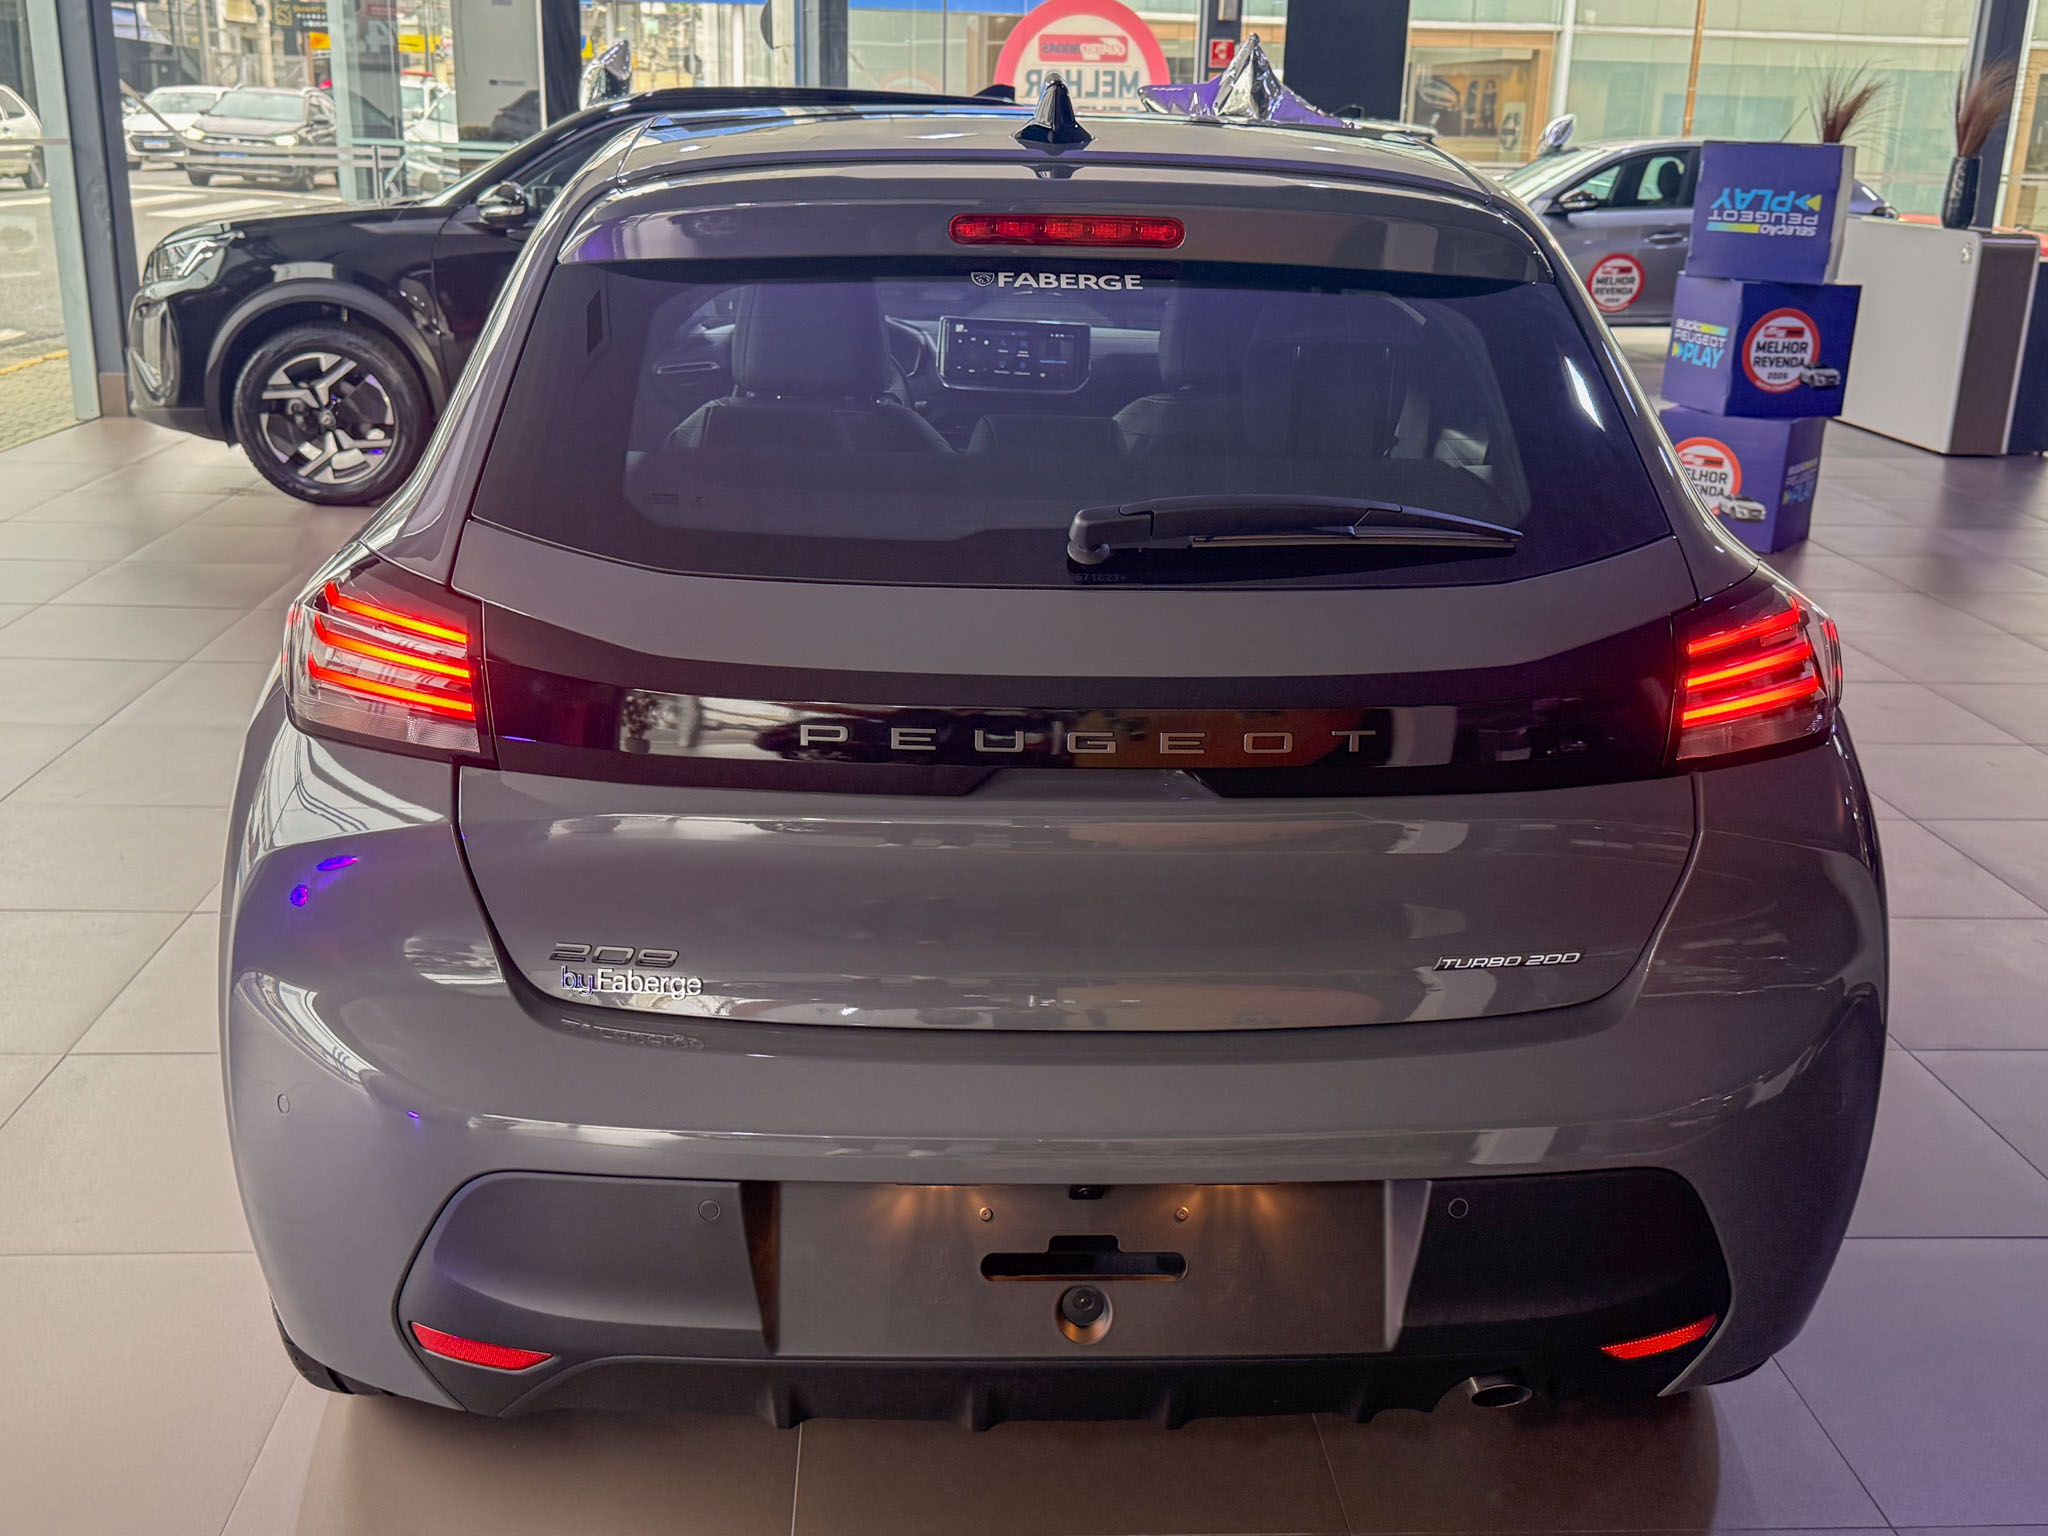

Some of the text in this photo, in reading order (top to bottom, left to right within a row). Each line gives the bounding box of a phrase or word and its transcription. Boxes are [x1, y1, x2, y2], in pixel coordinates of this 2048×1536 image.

[1711, 187, 1796, 212] PLAY
[1708, 210, 1819, 225] PEUGEOT
[1760, 224, 1817, 236] SELEÇÃO
[997, 272, 1144, 290] FABERGE
[1673, 328, 1727, 348] PEUGEOT
[1681, 342, 1725, 369] PLAY
[1755, 341, 1808, 354] MELHOR
[1753, 356, 1806, 368] REVENDA
[800, 723, 1376, 754] PEUGEOT
[550, 942, 679, 968] 208
[1442, 952, 1581, 969] TURBO 200
